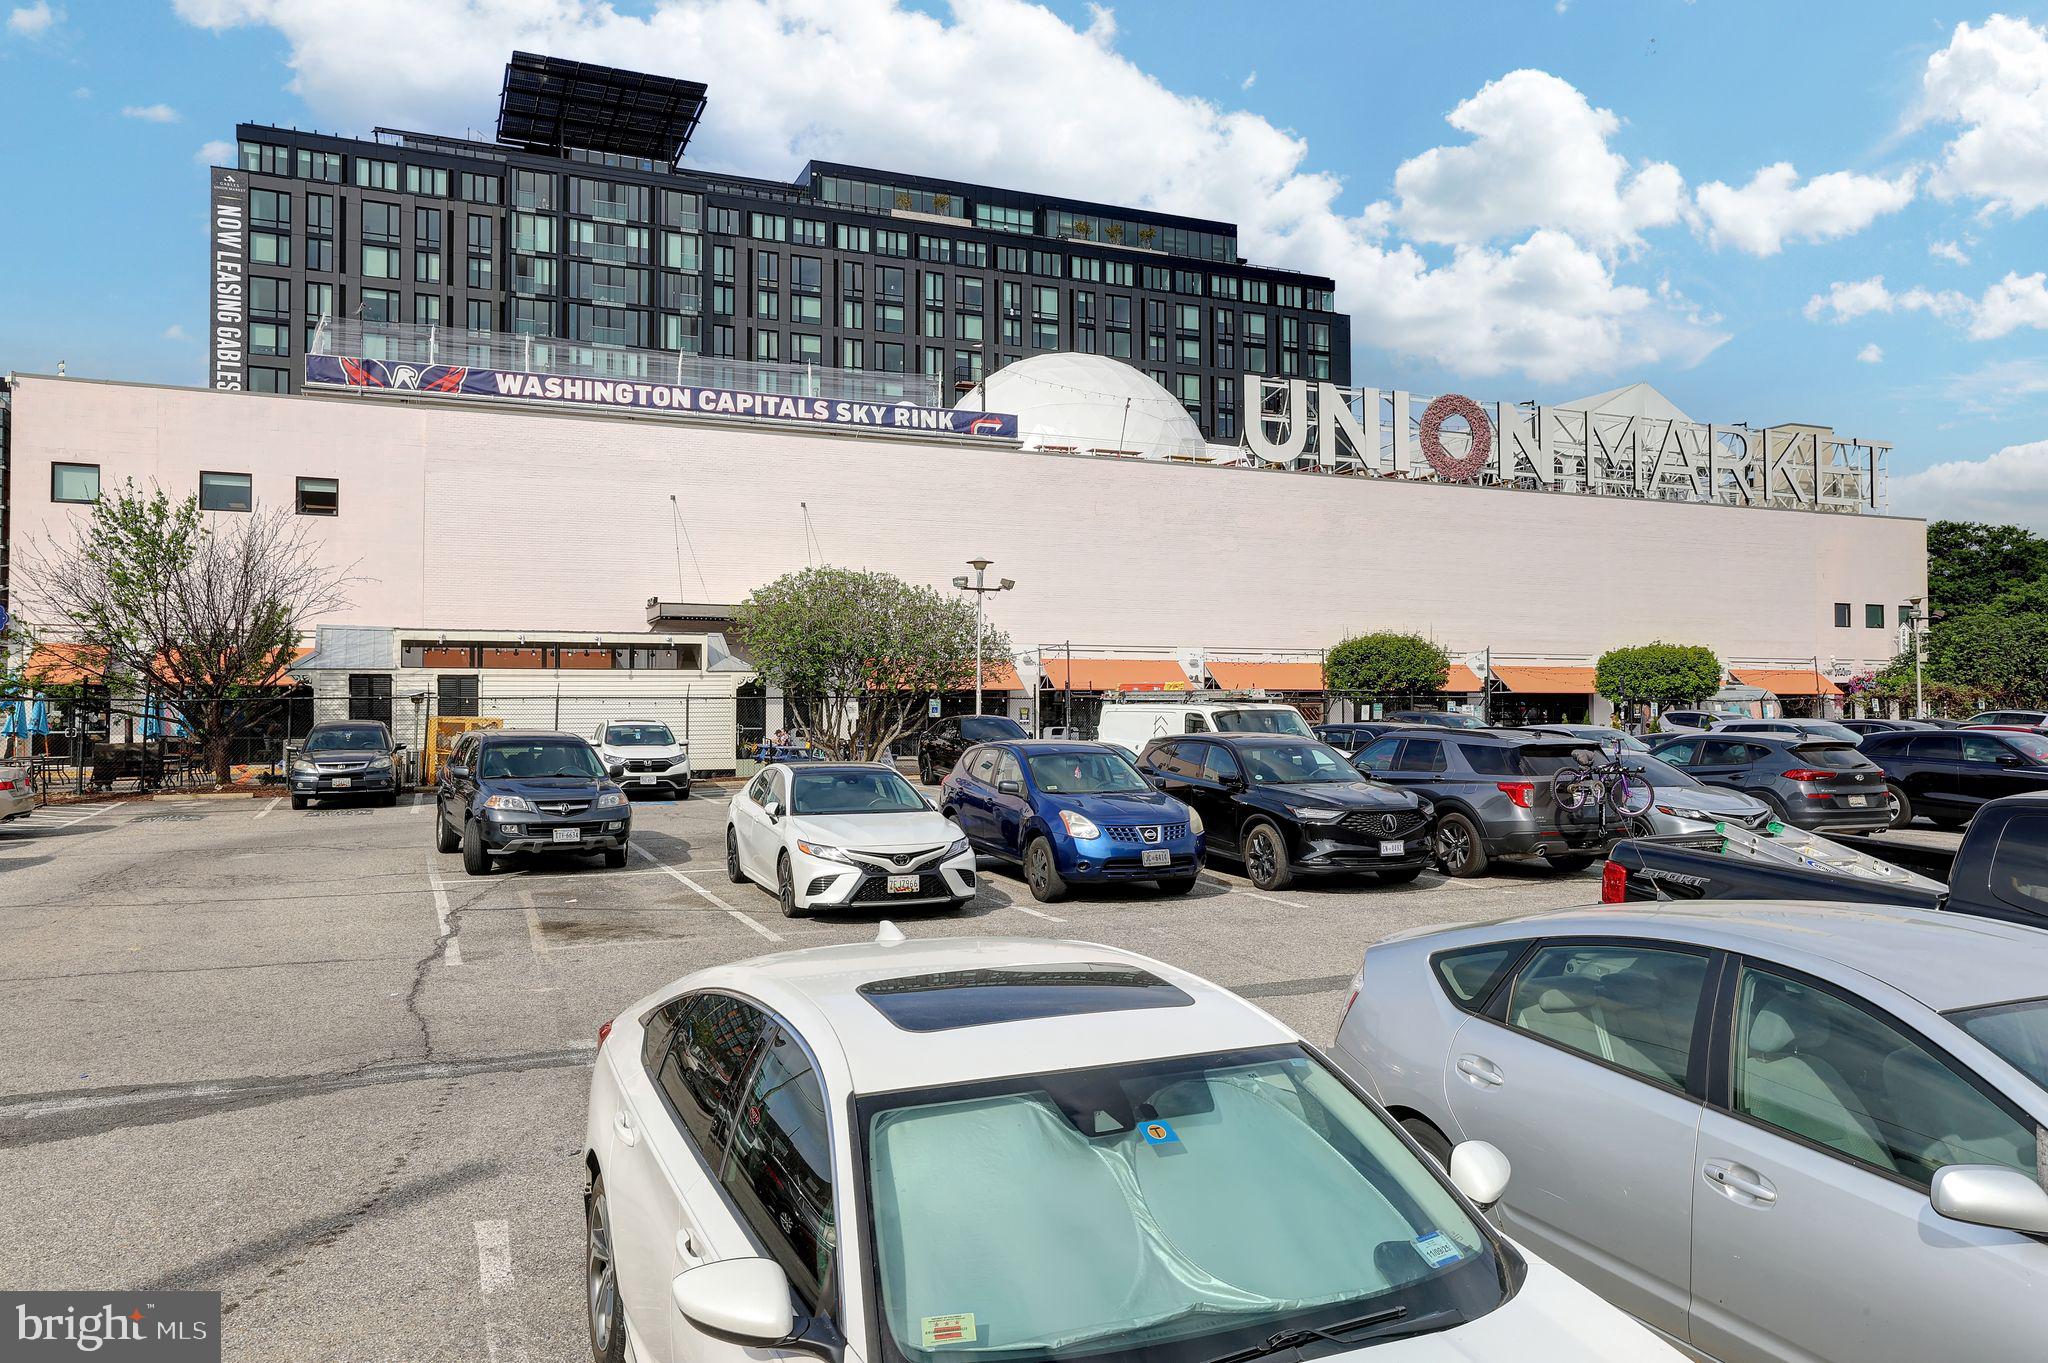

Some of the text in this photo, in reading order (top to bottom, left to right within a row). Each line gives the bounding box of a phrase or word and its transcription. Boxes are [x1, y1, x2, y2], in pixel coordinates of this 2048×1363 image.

[216, 204, 242, 392] NOW LEASING GABLES
[495, 372, 955, 431] WASHINGTON CAPITALS SKY RINK
[1243, 374, 1894, 508] UNION MARKET
[1633, 867, 1711, 887] SPORT
